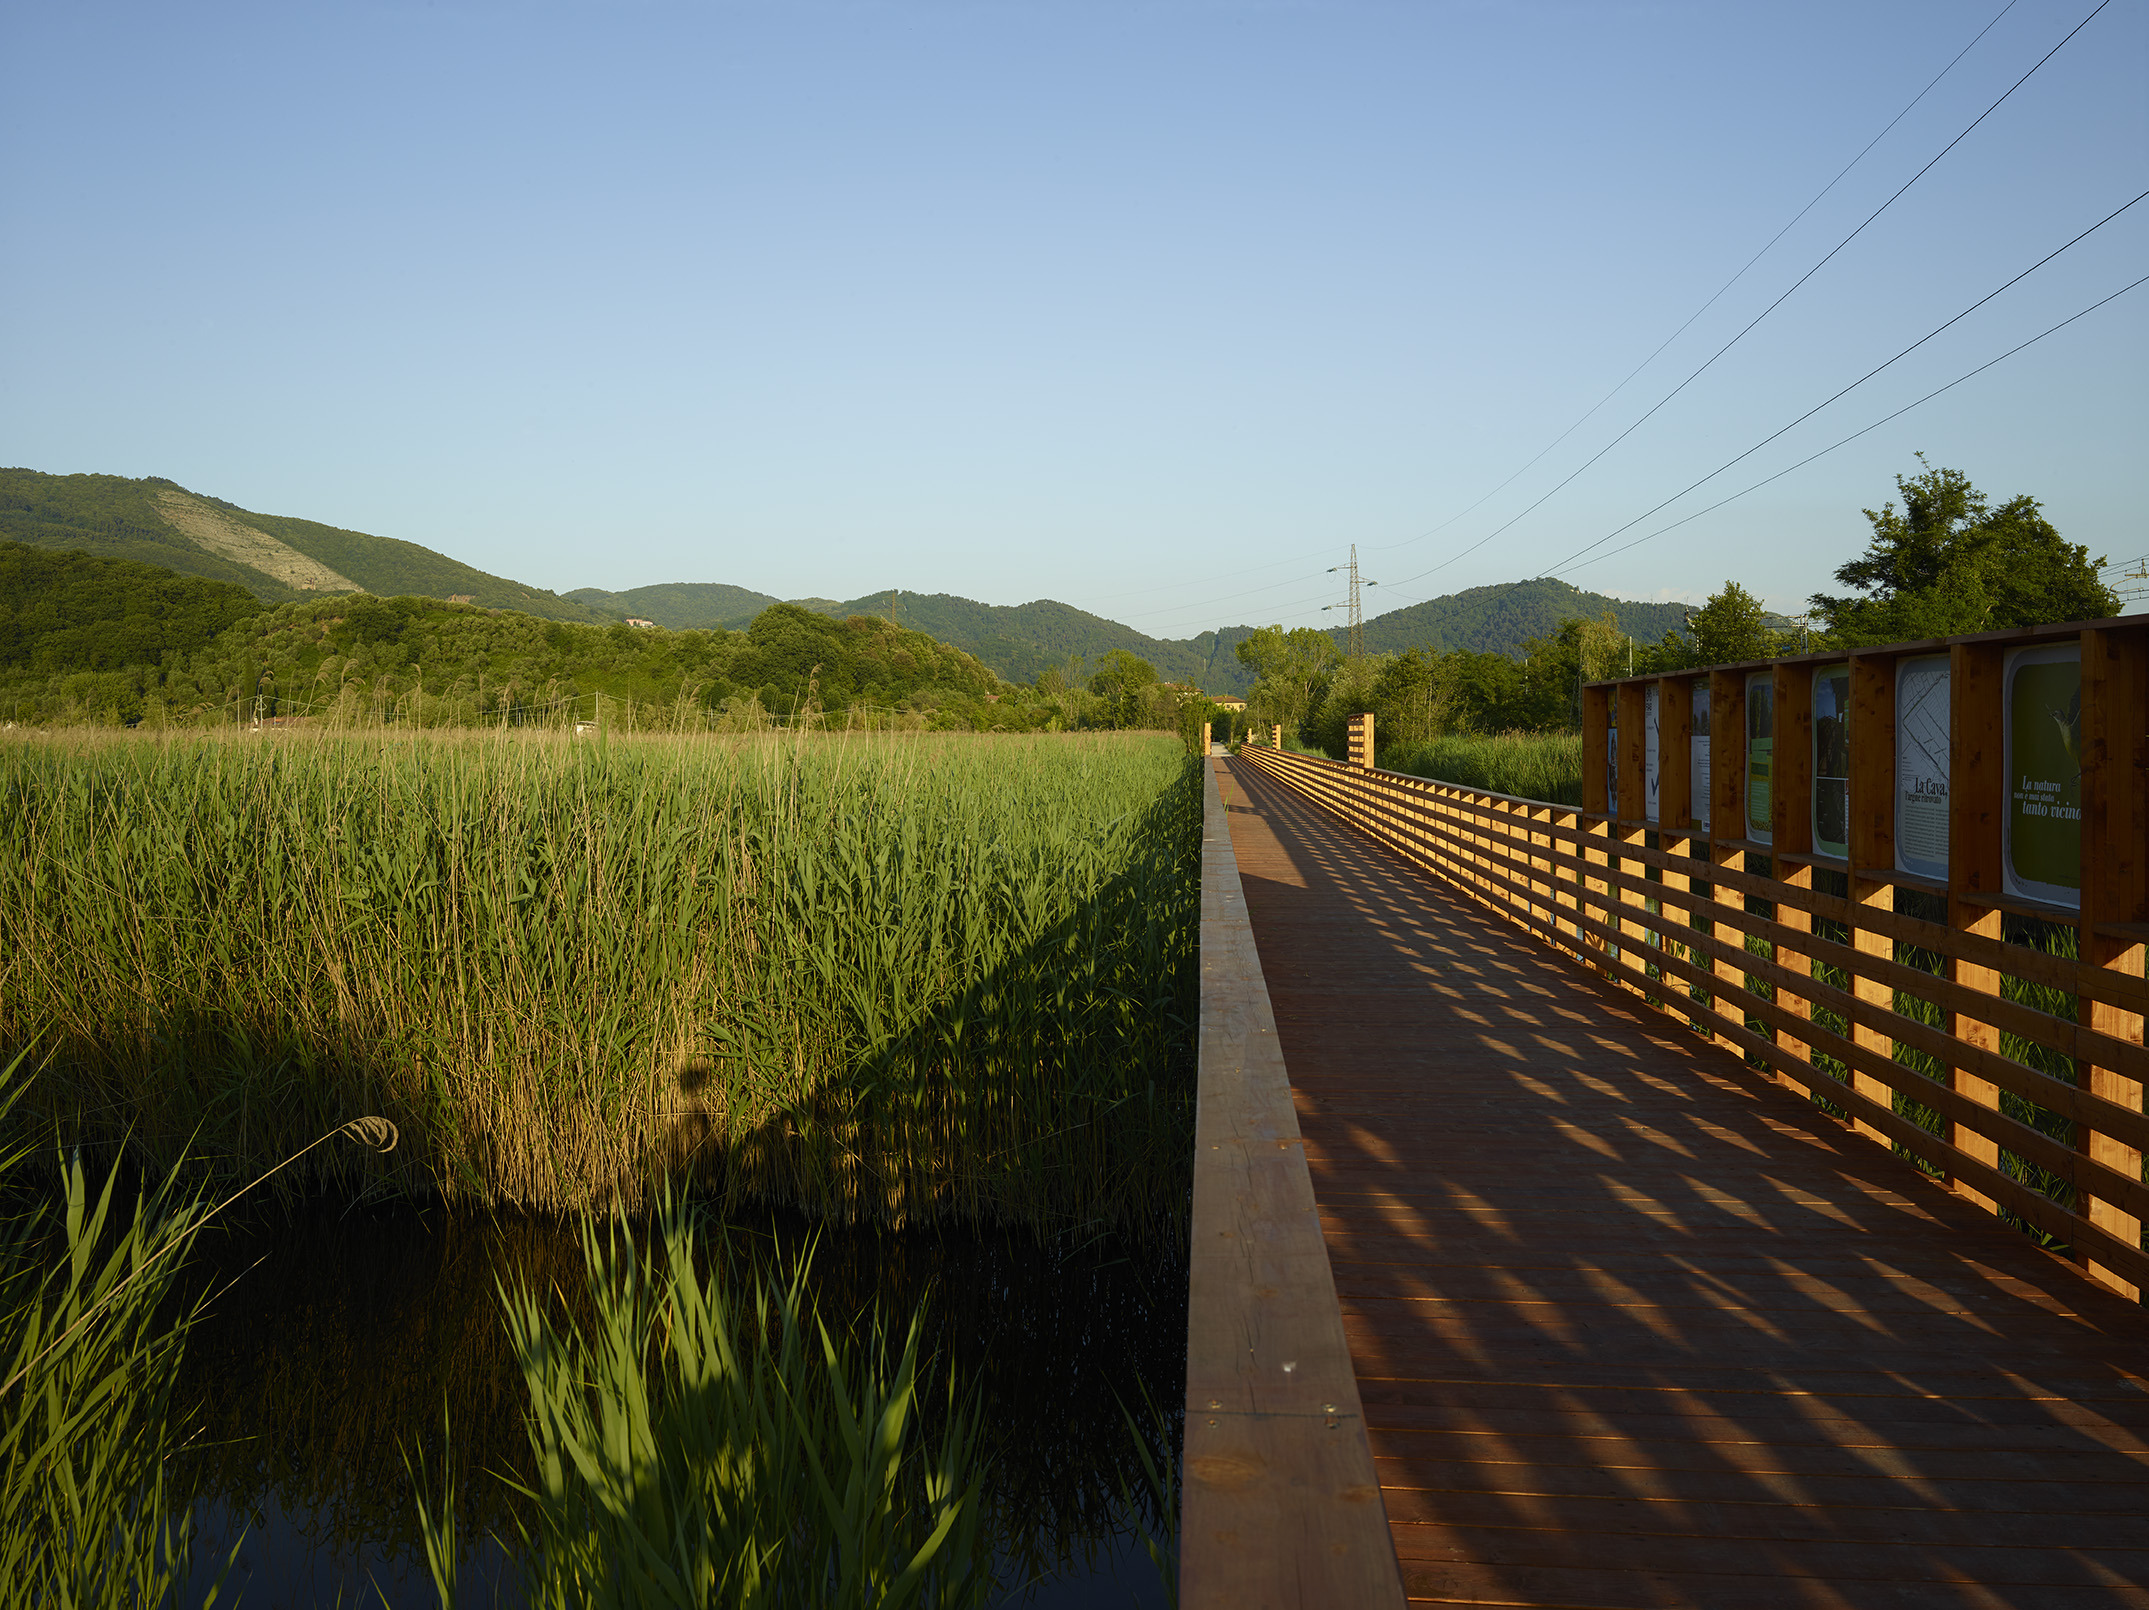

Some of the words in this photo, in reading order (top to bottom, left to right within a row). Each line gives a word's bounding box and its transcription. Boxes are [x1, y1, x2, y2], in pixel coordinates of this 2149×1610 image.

[1915, 777, 1924, 793] La
[1926, 778, 1947, 800] Cava,
[2023, 775, 2032, 790] La
[2034, 780, 2061, 792] natura
[2029, 791, 2039, 801] mai
[2040, 793, 2055, 802] stata
[2022, 800, 2048, 817] tanto
